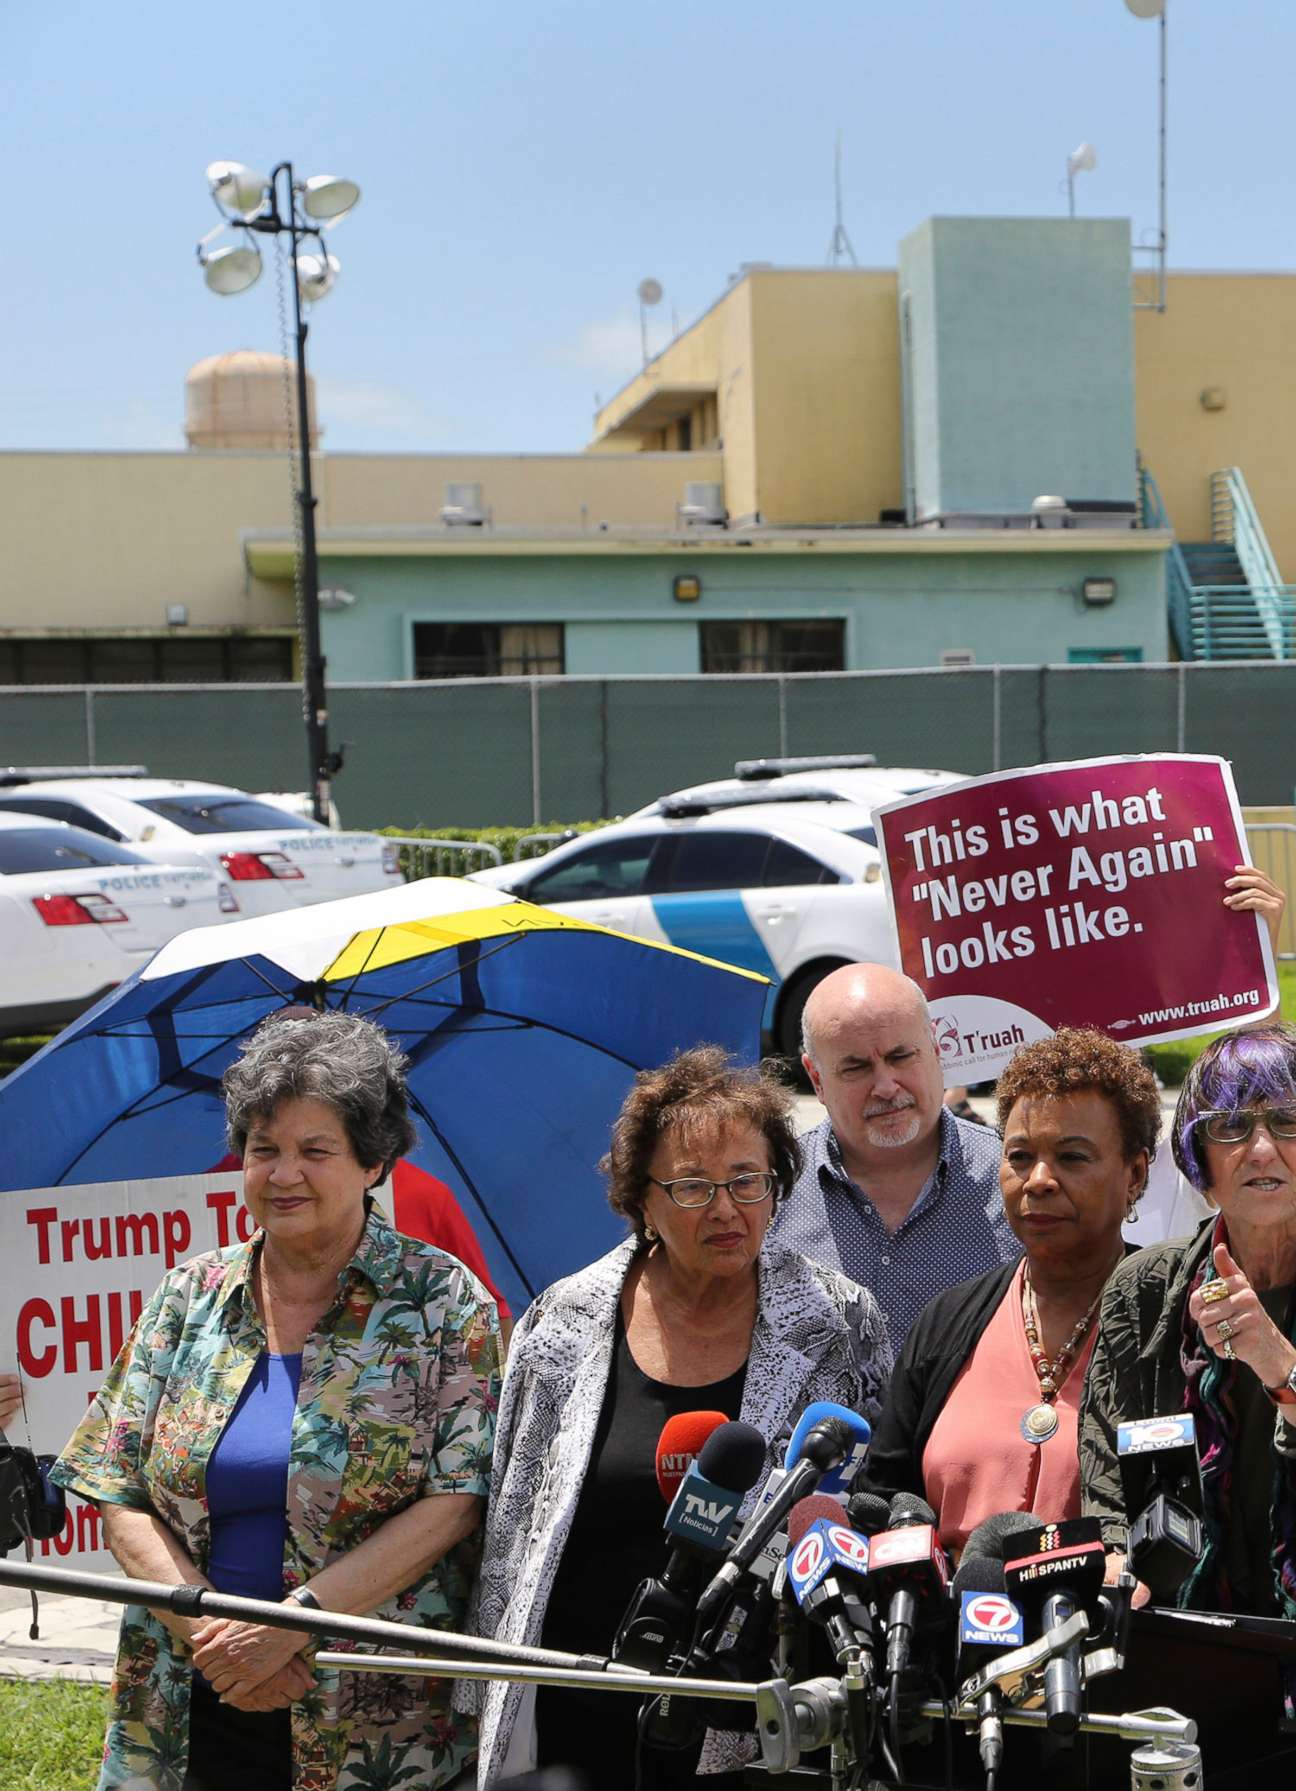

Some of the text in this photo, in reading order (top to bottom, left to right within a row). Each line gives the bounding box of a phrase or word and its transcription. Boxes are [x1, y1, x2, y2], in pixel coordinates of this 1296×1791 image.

[279, 838, 335, 851] POLICE
[904, 787, 1166, 872] This is what
[99, 875, 161, 891] POLICE
[912, 827, 1214, 922] "Never Again"
[921, 902, 1144, 978] looks like.
[1139, 989, 1258, 1026] www.truah.org
[963, 1024, 1025, 1054] T'ruah
[26, 1207, 192, 1270] Trump
[1126, 1423, 1185, 1445] 10
[1128, 1439, 1185, 1454] NEWS
[800, 1556, 831, 1600] NEWS
[965, 1630, 1020, 1643] NEWS
